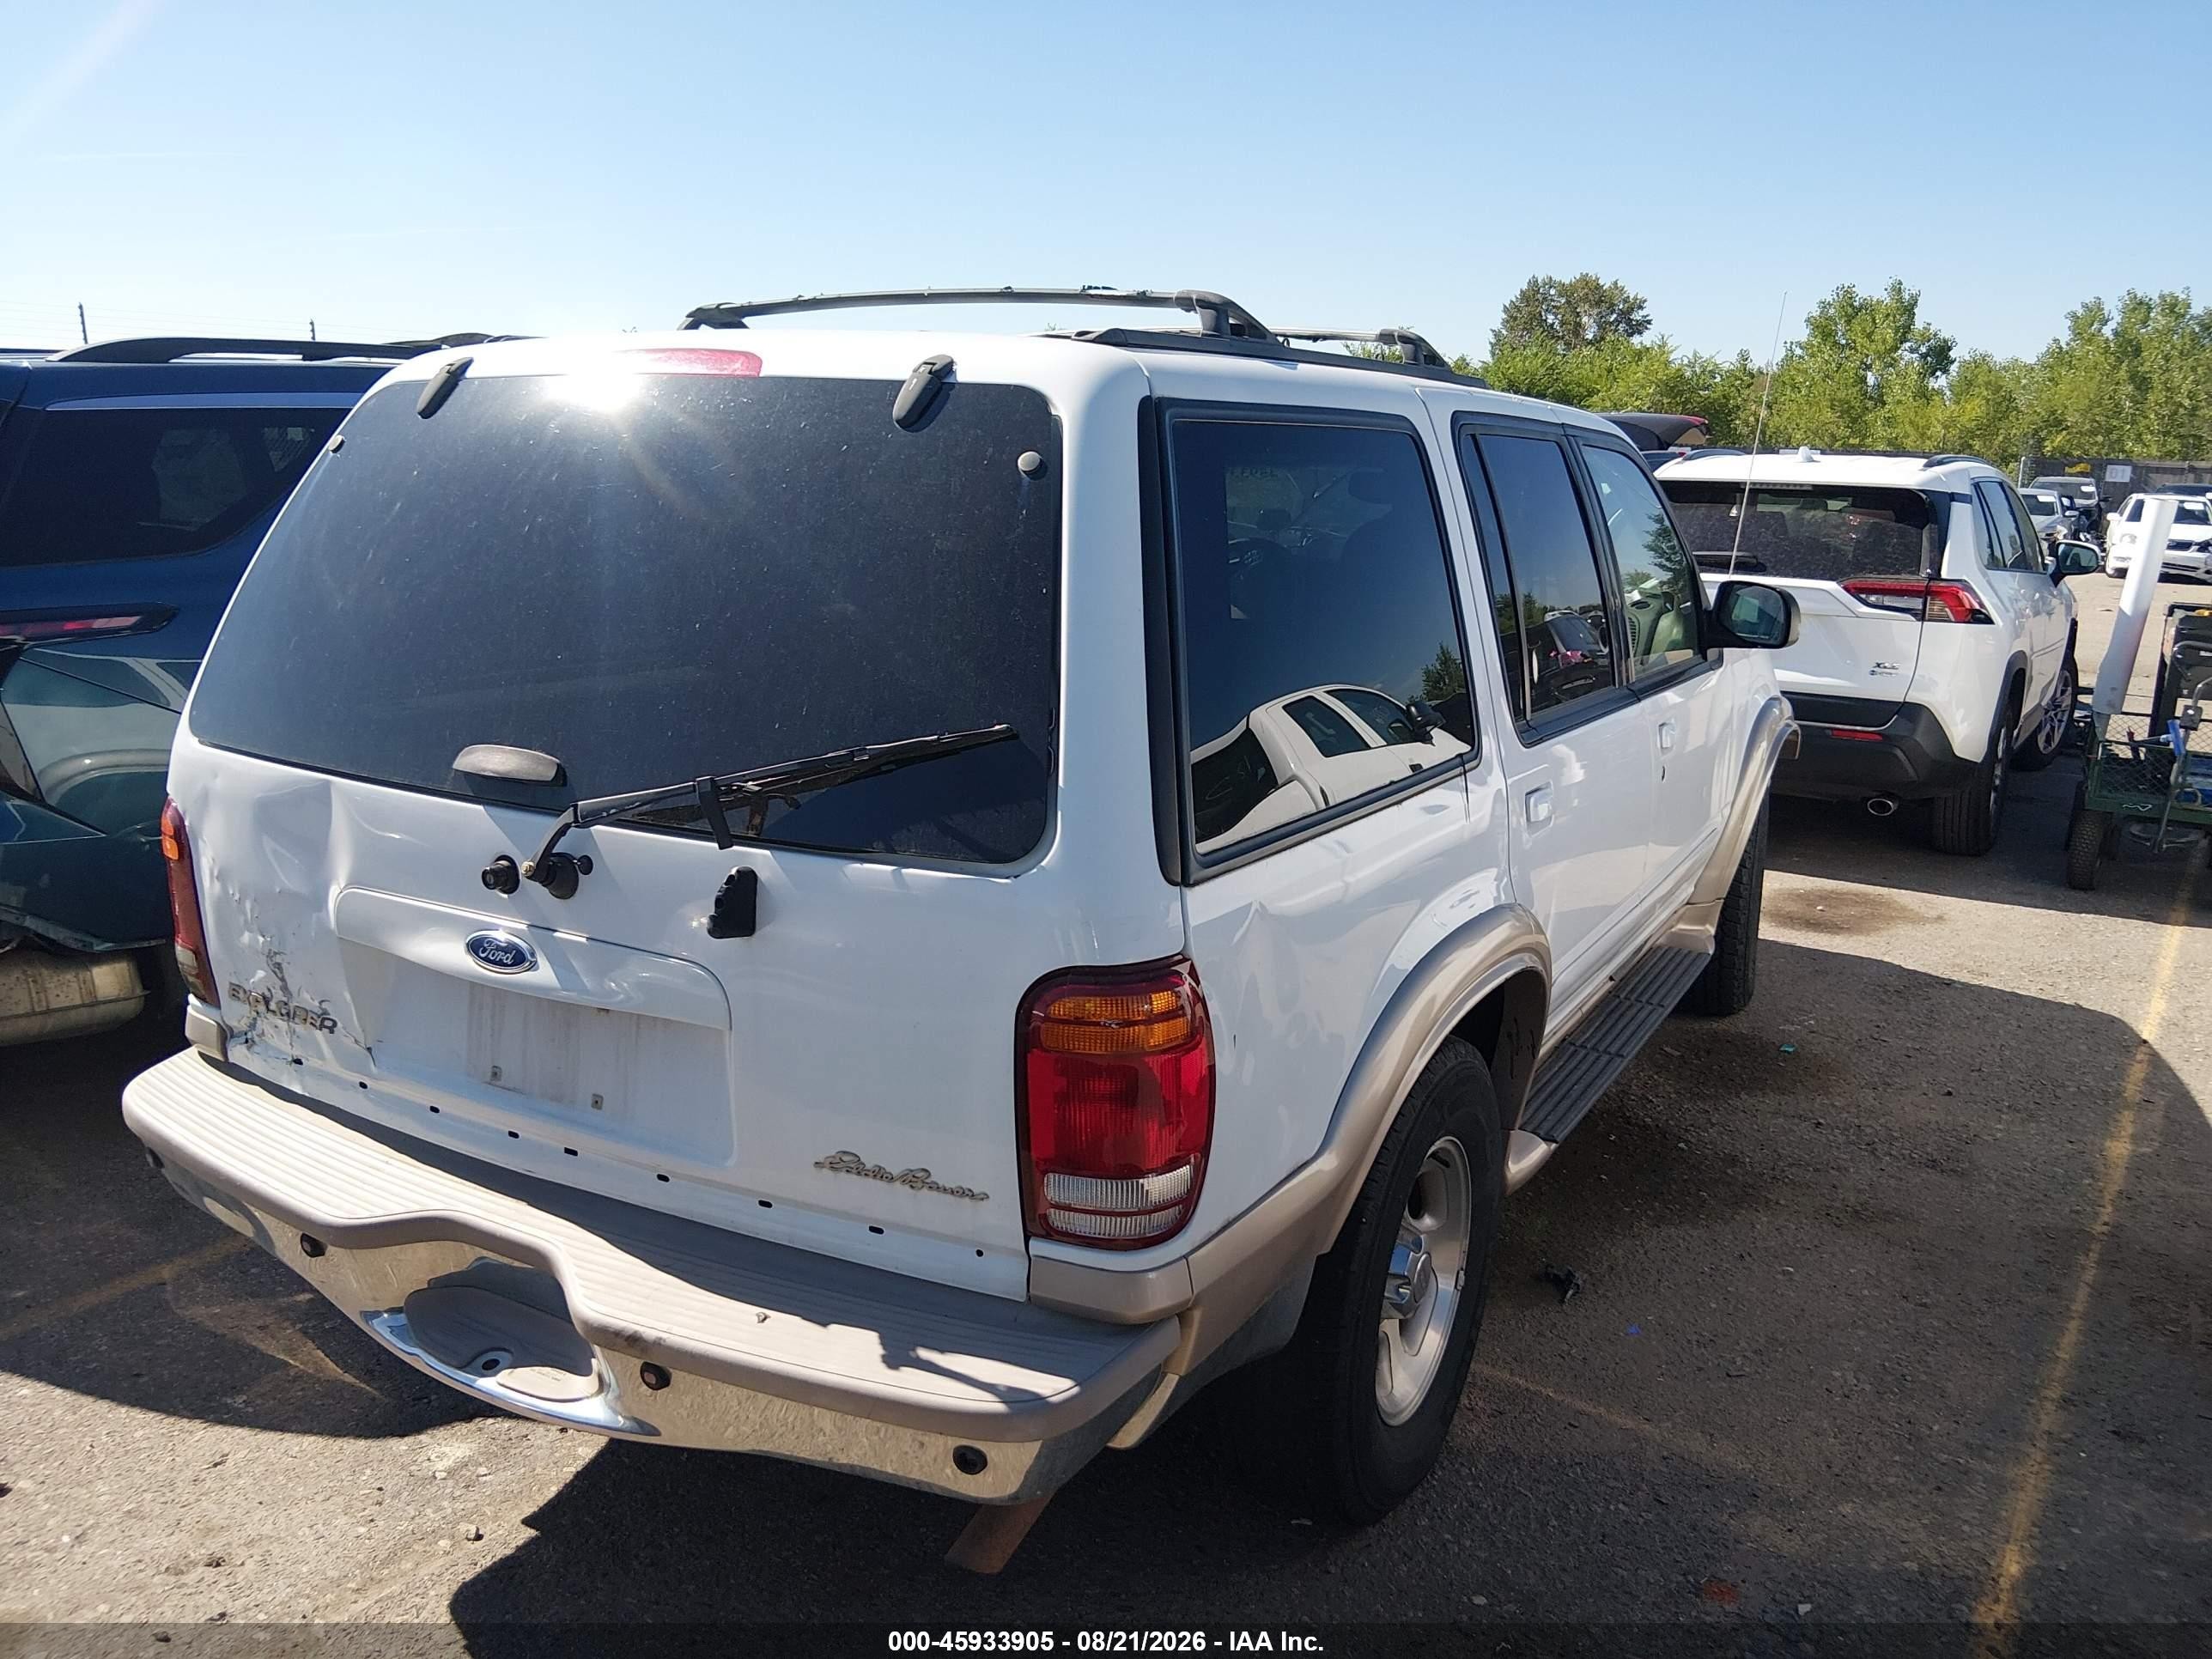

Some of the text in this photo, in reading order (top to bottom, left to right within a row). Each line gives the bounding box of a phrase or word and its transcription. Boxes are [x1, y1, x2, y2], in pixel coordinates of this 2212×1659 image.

[479, 938, 516, 964] Ford
[813, 1151, 990, 1201] Eddie Bauer
